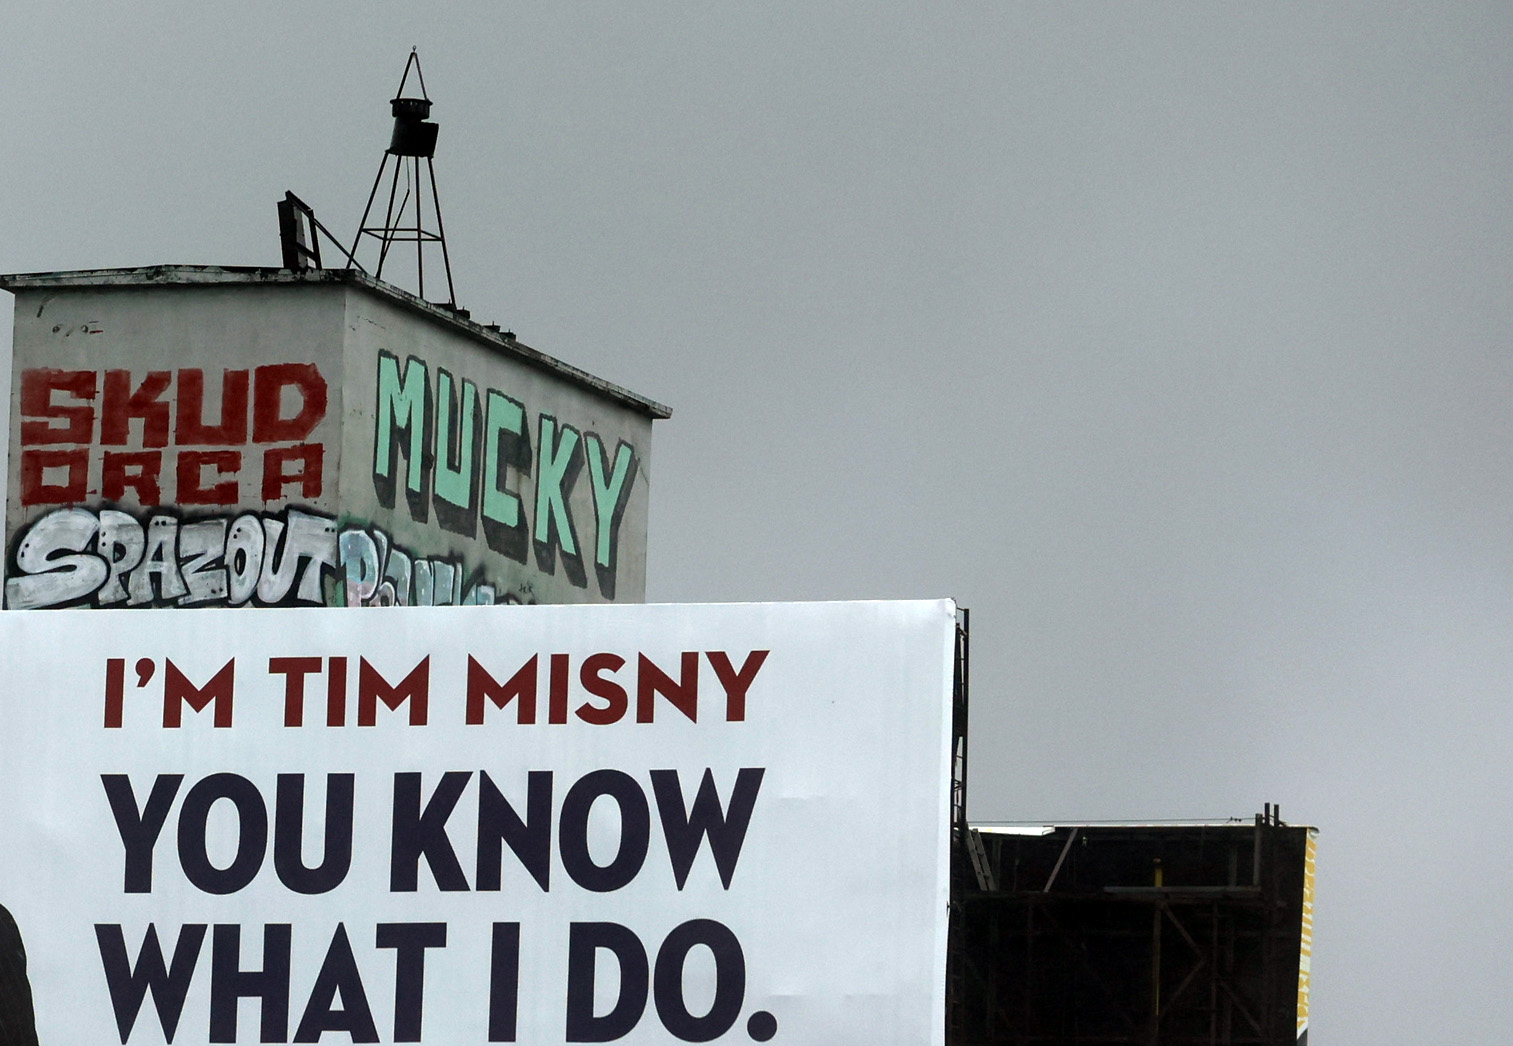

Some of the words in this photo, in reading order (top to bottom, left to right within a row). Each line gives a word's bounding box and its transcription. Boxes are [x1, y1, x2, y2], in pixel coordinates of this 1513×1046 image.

[20, 362, 328, 448] SKUD
[20, 443, 326, 506] ORCA
[373, 348, 638, 600] MUCKY
[5, 507, 338, 610] SPAZOUT
[103, 656, 235, 728] I’M
[268, 654, 430, 727] TIM
[465, 650, 770, 726] MISNY
[100, 772, 355, 895] YOU
[389, 767, 766, 893] KNOW
[94, 921, 447, 1045] WHAT
[488, 921, 520, 1043] I
[565, 918, 778, 1043] DO.
